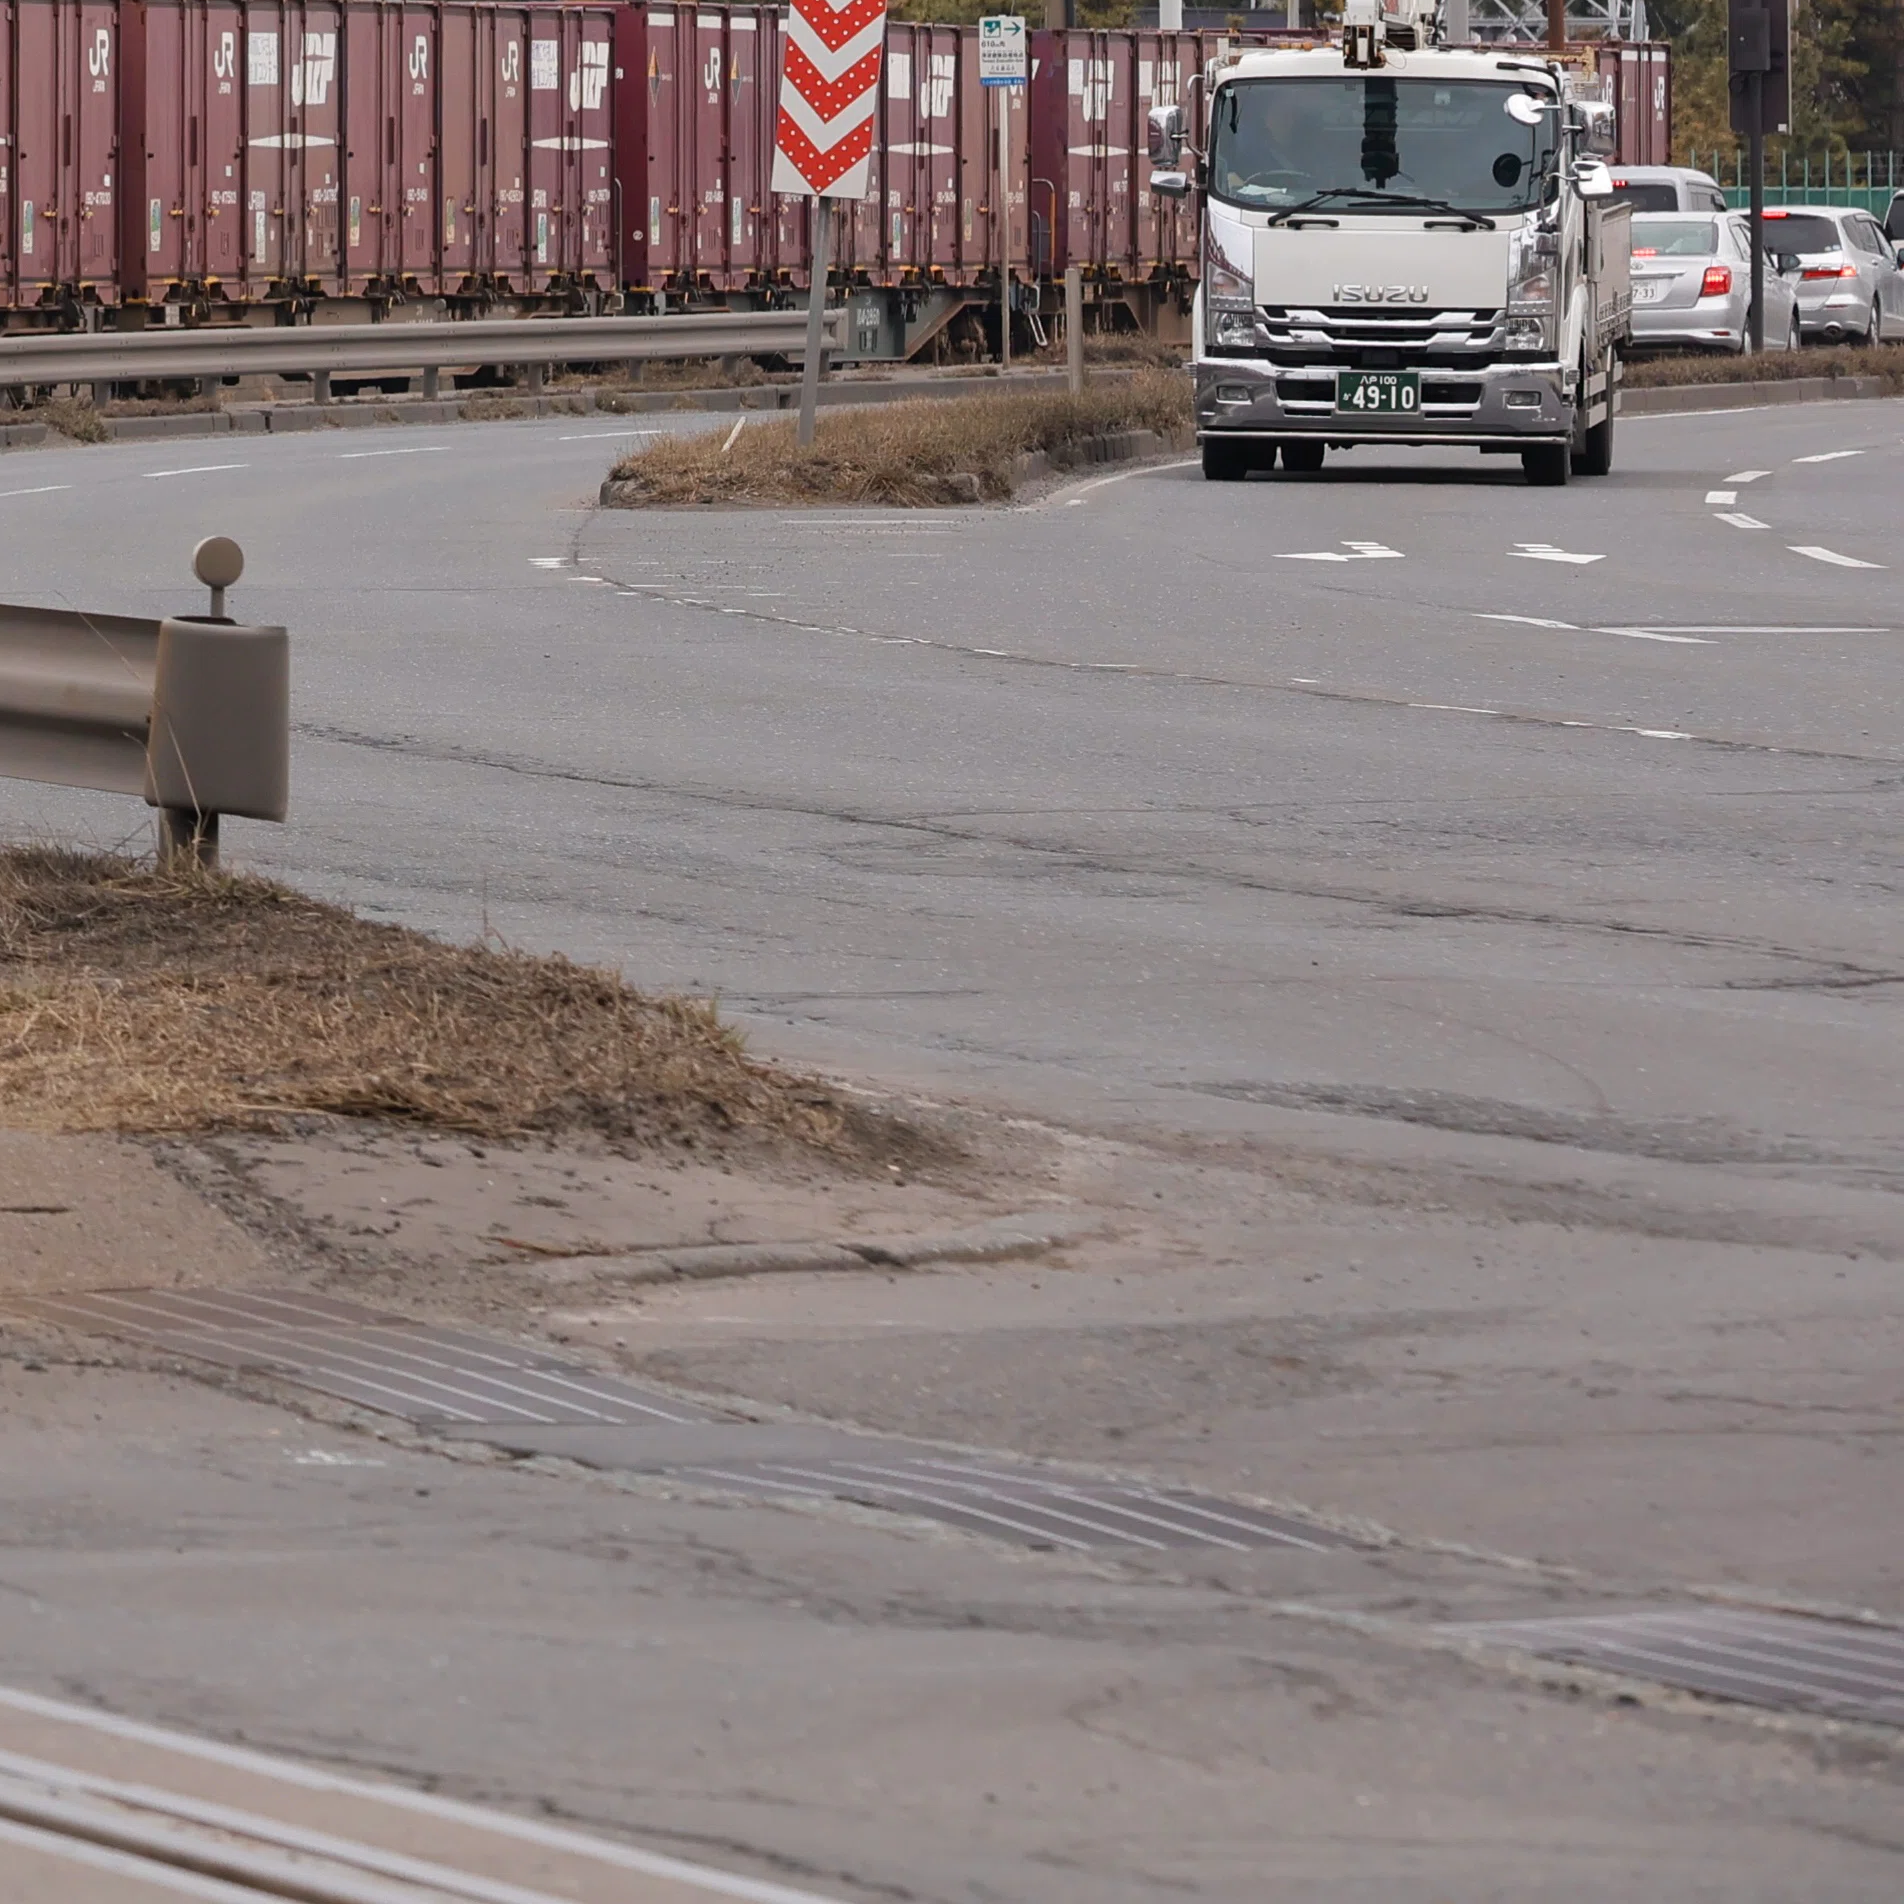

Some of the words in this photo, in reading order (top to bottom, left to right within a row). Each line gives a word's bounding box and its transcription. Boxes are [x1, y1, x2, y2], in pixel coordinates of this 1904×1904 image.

[89, 28, 110, 77] JR
[214, 31, 234, 79] JR
[408, 35, 428, 80] JR
[501, 40, 519, 83] JR
[704, 47, 721, 90] JR
[1332, 283, 1430, 304] ISUZU
[1352, 385, 1415, 409] 49-10
[1379, 376, 1397, 385] 100
